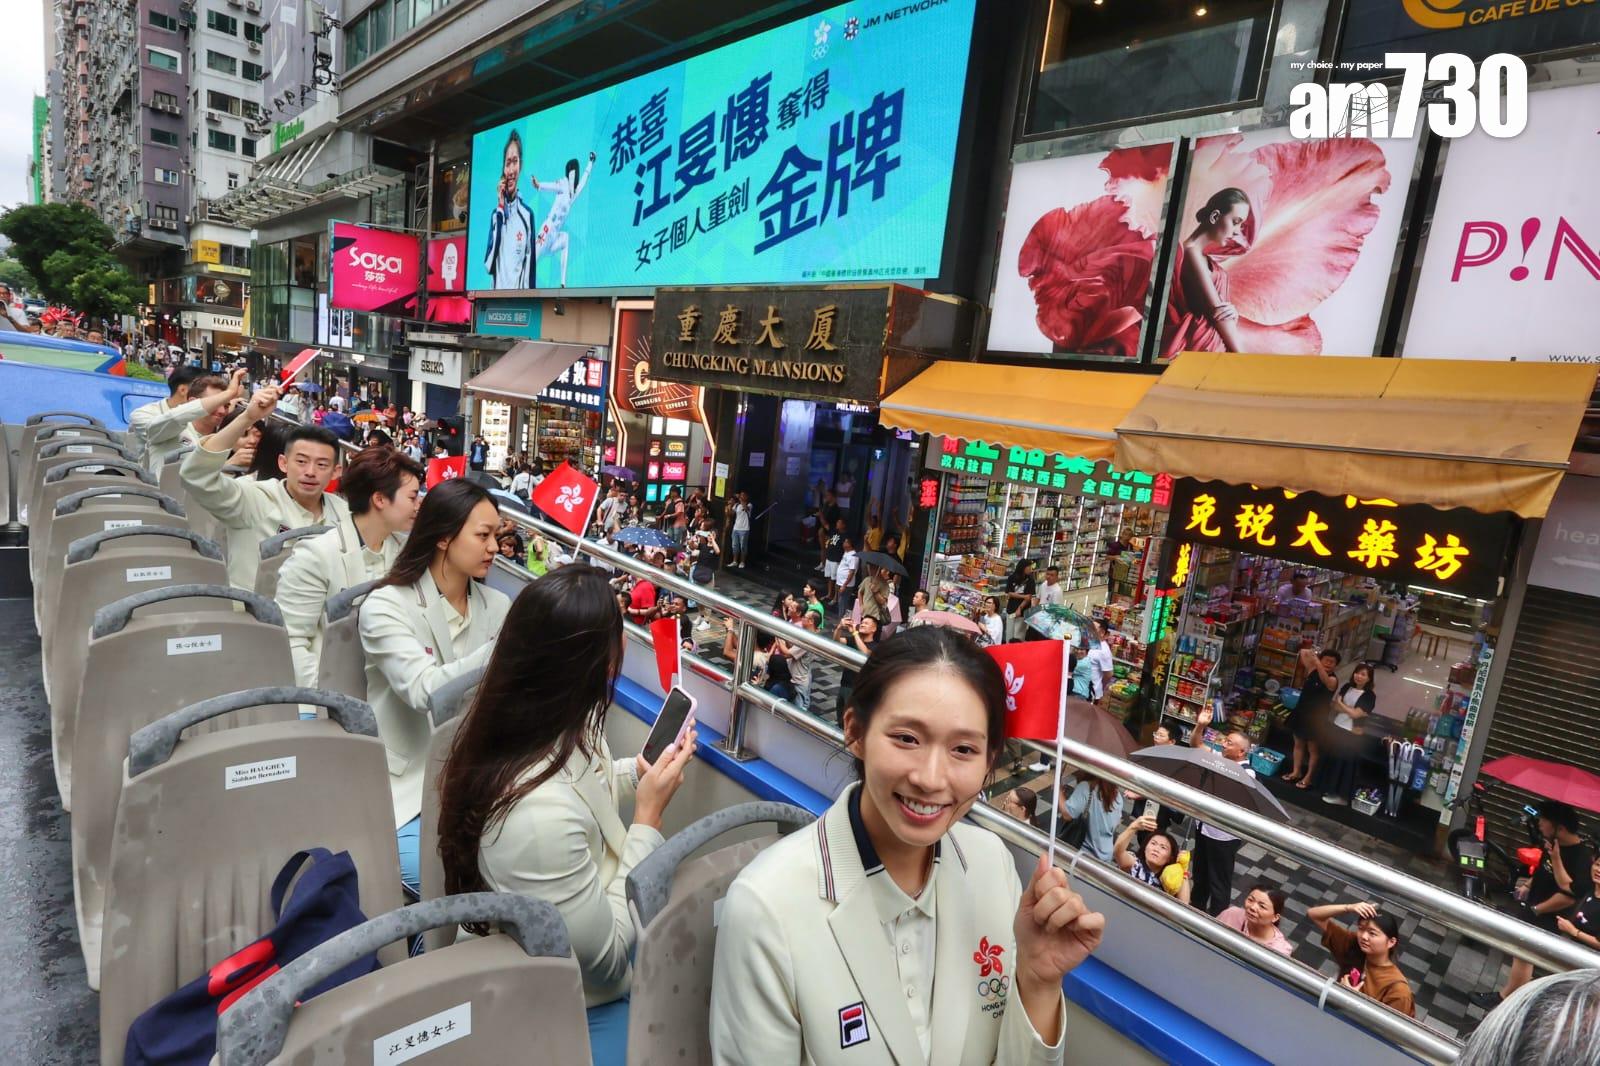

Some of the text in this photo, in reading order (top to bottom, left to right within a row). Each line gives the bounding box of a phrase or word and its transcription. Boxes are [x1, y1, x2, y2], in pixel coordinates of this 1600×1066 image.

[863, 15, 880, 28] JM
[1469, 0, 1560, 24] CAFE DE
[776, 68, 830, 130] 奪得
[610, 87, 669, 176] 恭喜
[633, 71, 772, 226] 江旻憓
[754, 88, 905, 256] 金牌
[635, 176, 750, 272] 女子個人重劍
[420, 360, 444, 375] SEIKO
[663, 351, 845, 384] CHUNGKING MANSIONS
[250, 763, 285, 774] HAUGHEY
[981, 1002, 1000, 1012] HONG
